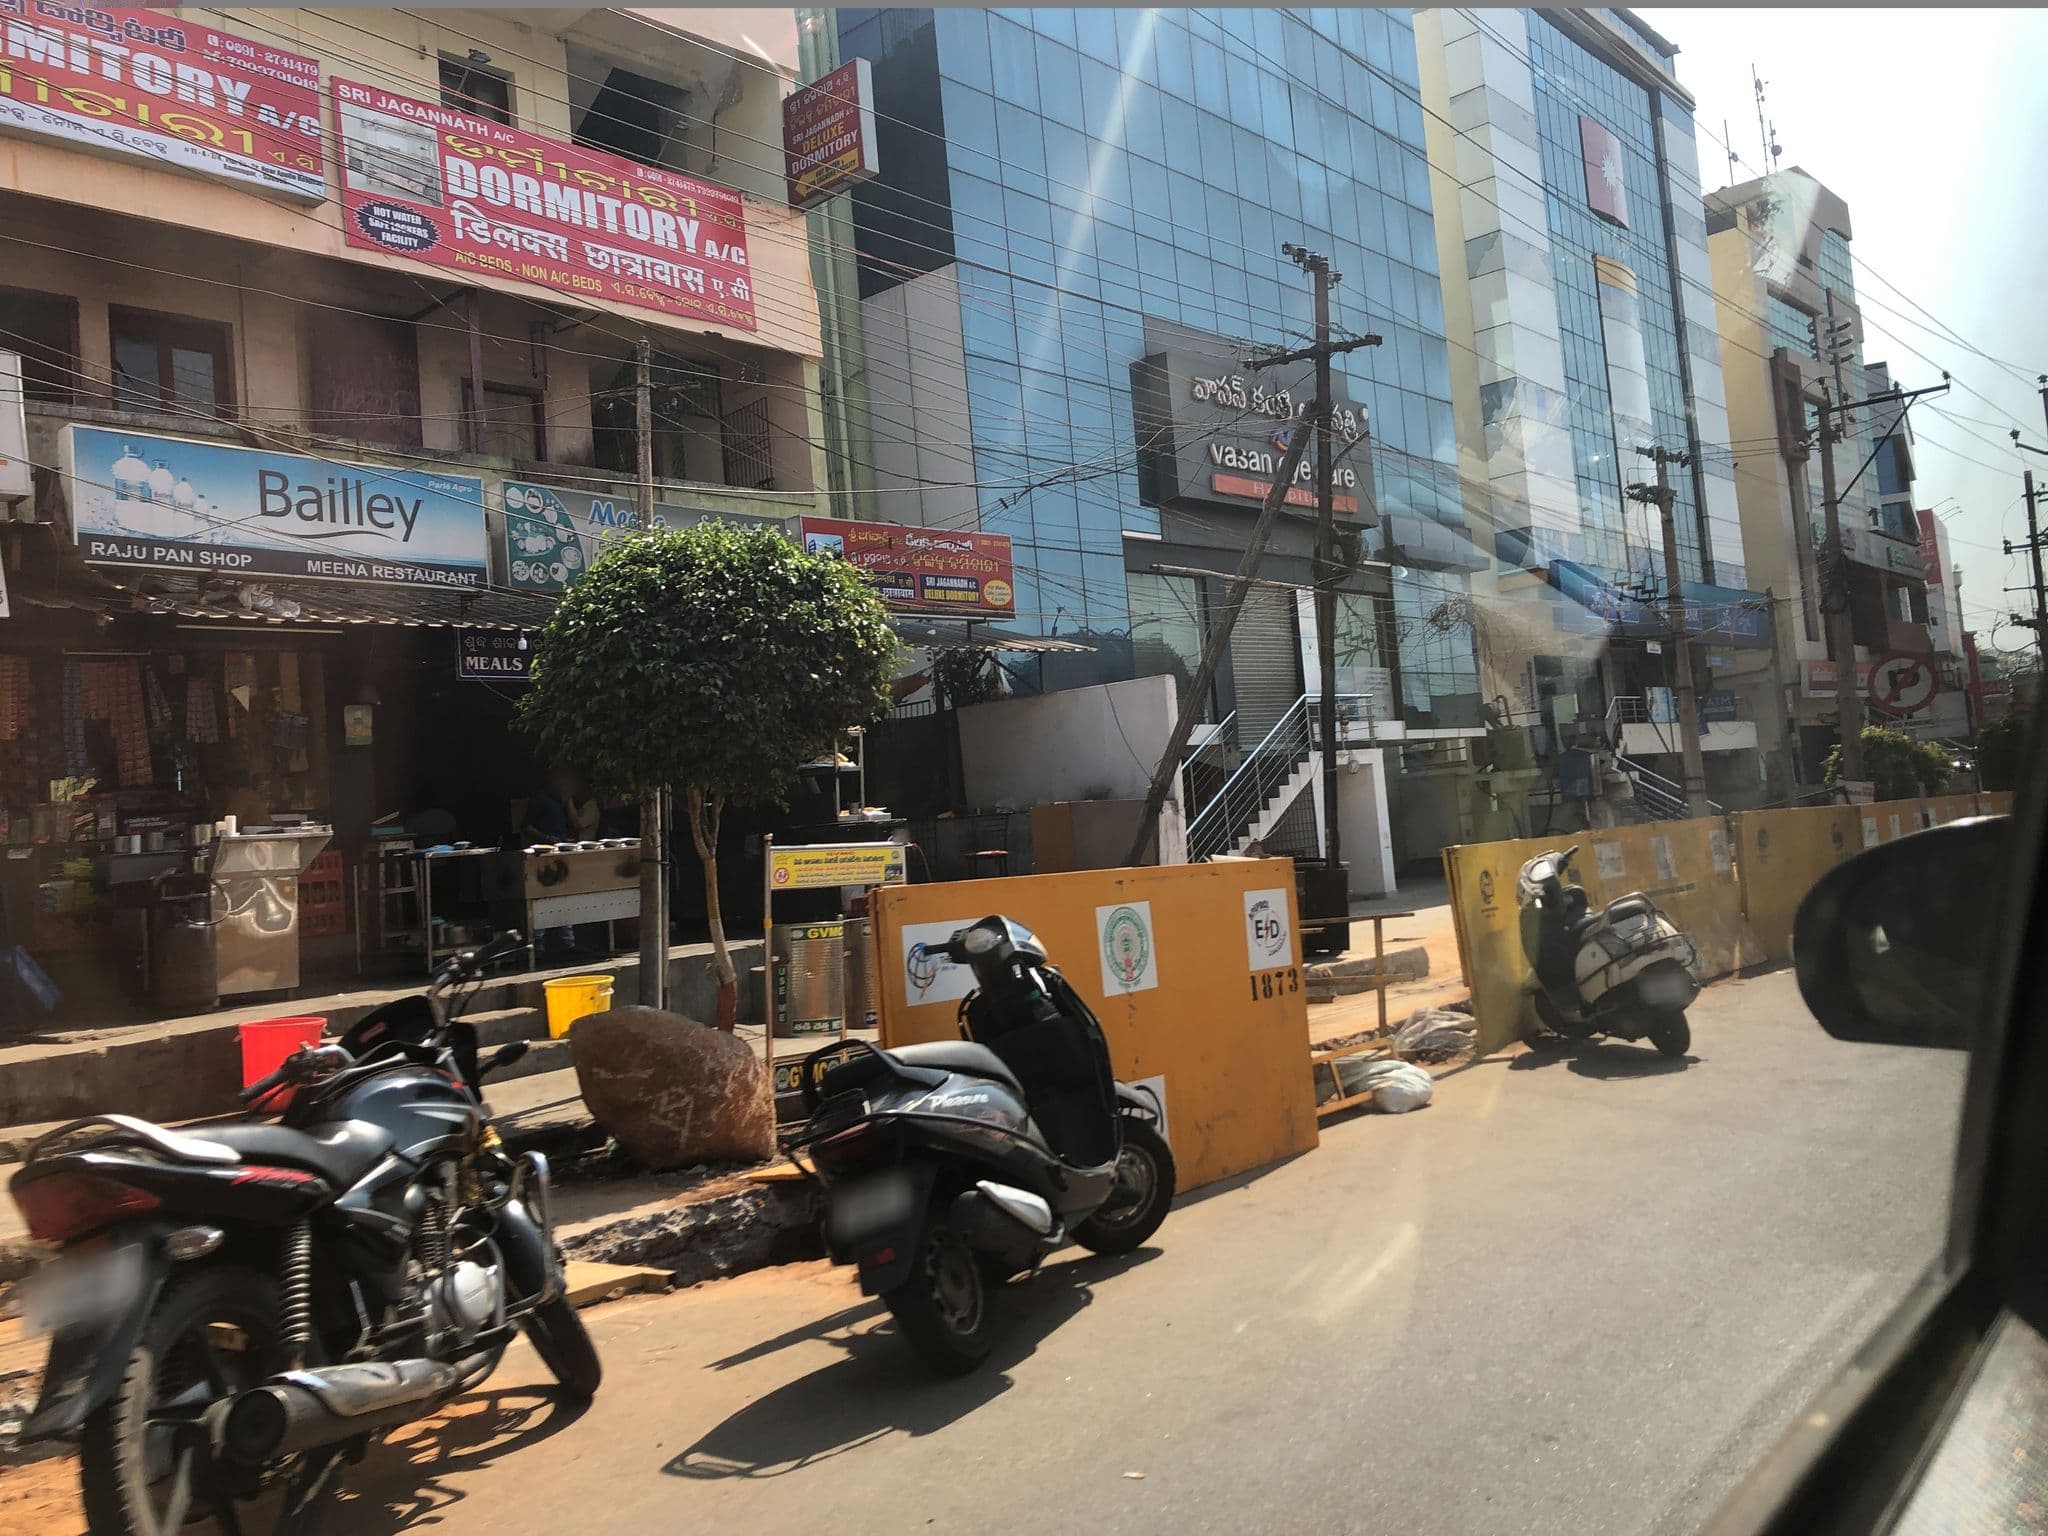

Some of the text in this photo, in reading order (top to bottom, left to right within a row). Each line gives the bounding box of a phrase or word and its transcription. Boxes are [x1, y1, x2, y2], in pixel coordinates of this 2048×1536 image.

[0, 18, 321, 137] MITORY A/C
[265, 52, 318, 76] 2741479
[338, 85, 516, 144] SRI JAGANNATH A/C
[791, 129, 859, 175] DORMITORY
[802, 121, 845, 154] DELUXE
[368, 217, 389, 229] SAFE
[373, 206, 422, 225] HOT WATER
[445, 155, 747, 266] DORMITORY A/C
[381, 232, 418, 247] FACILITY
[479, 256, 512, 273] BEDS
[522, 262, 547, 281] NON
[551, 269, 570, 286] A/C
[572, 275, 603, 293] BEDS
[1210, 442, 1273, 474] vasan
[1278, 456, 1312, 485] ye
[452, 483, 473, 493] Agro
[258, 469, 425, 542] Bailley
[90, 540, 253, 569] RAJU PAN SHOP
[307, 559, 478, 586] MEENA RESTAURANT
[465, 656, 523, 671] MEALS
[1249, 967, 1299, 1002] 1873
